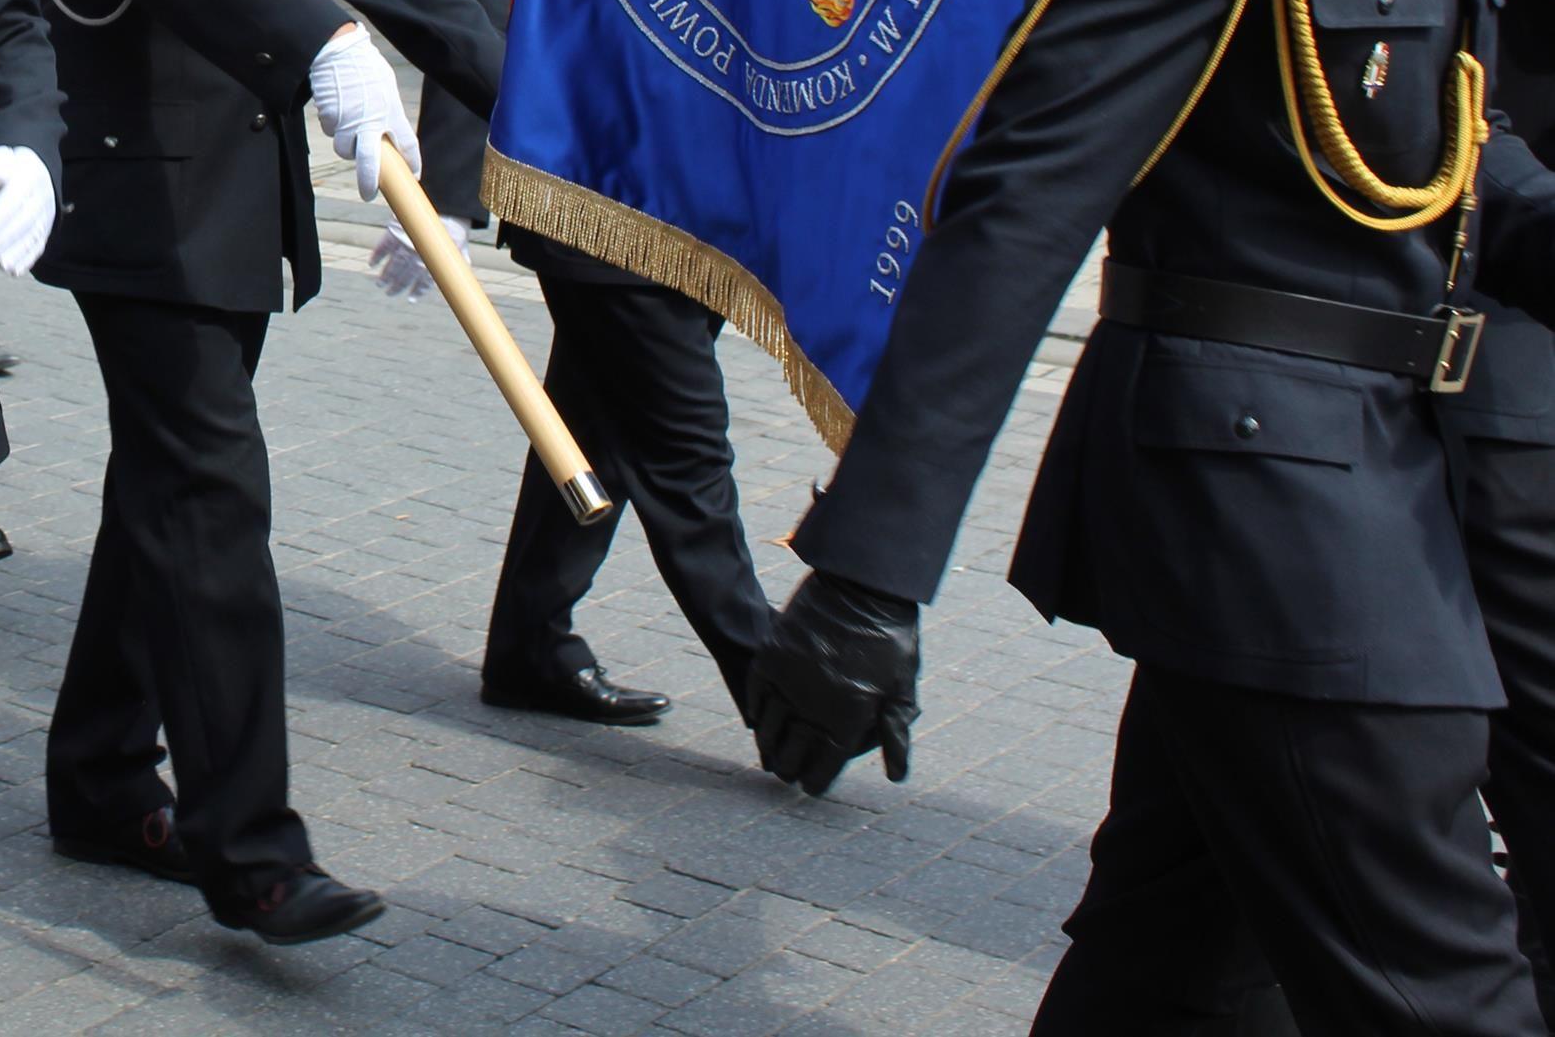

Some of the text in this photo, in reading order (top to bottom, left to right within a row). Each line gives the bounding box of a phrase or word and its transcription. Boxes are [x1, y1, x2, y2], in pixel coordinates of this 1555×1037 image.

[745, 60, 856, 114] KOMENDA
[869, 6, 902, 55] W
[870, 200, 919, 305] 1999
